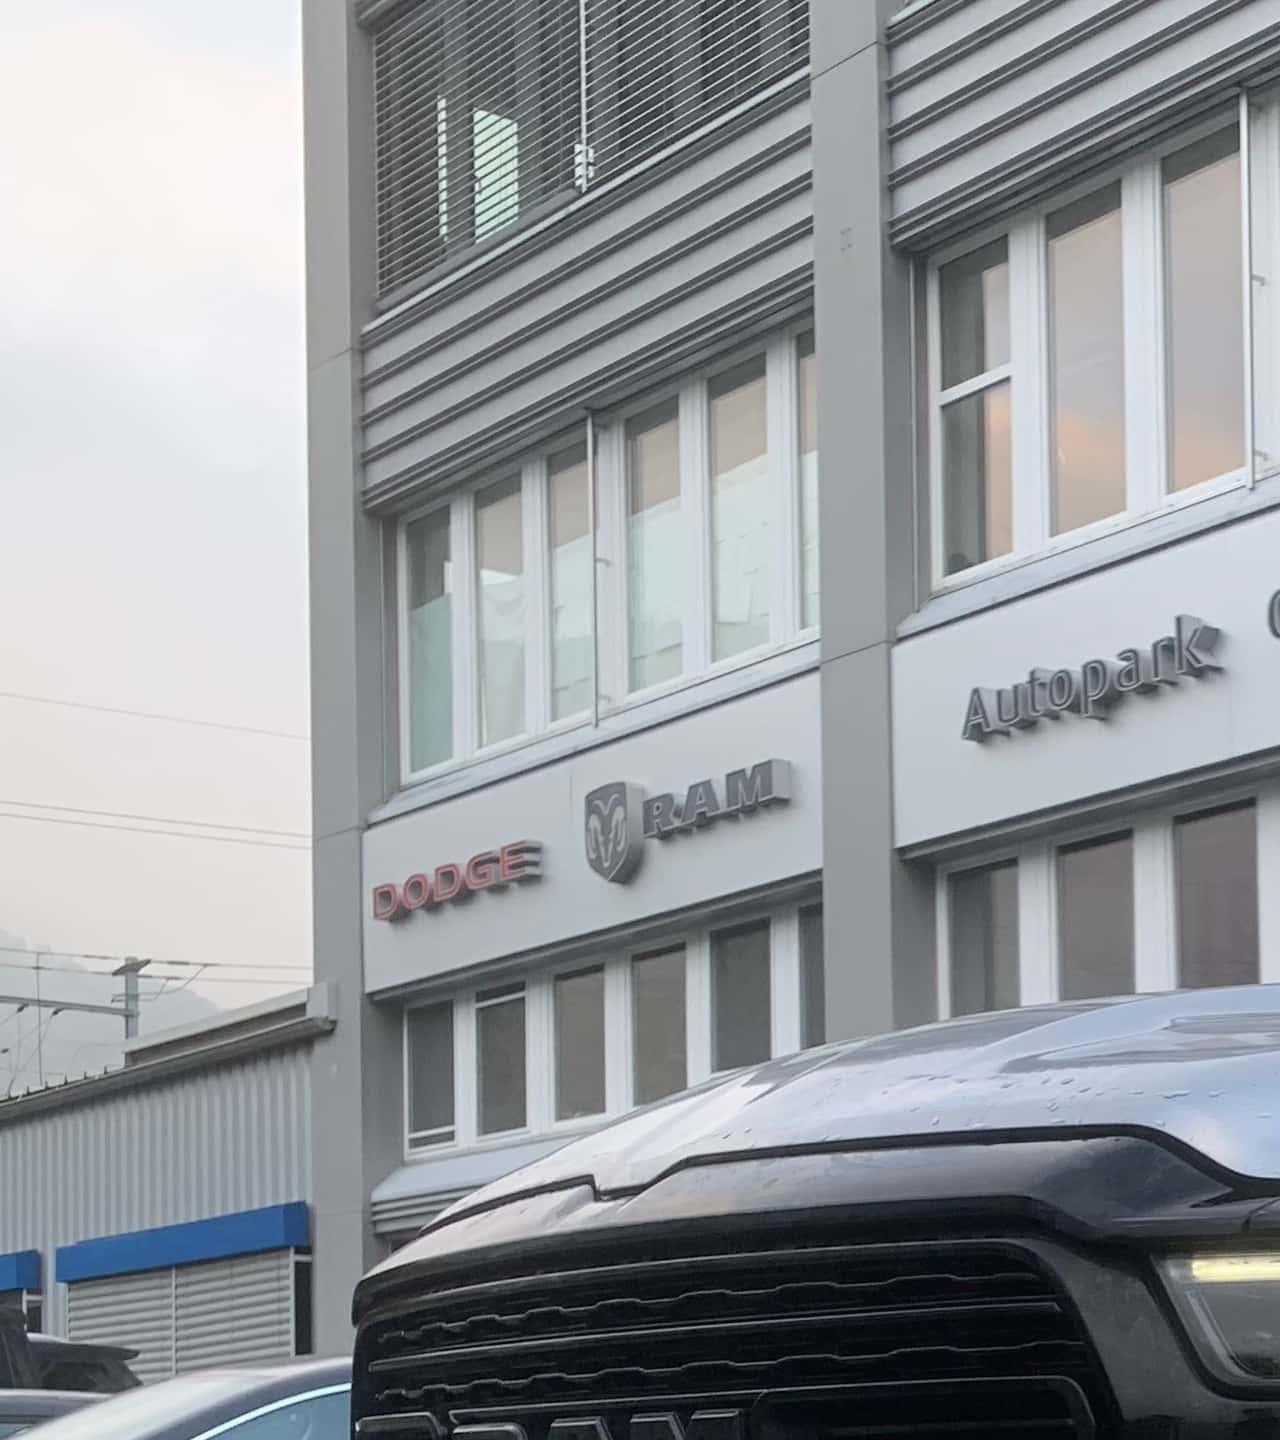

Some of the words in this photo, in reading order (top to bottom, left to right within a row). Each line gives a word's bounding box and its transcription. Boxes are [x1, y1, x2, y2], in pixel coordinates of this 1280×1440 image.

[962, 614, 1224, 743] Autopark
[643, 758, 792, 839] RAM
[372, 840, 543, 921] DODGE
